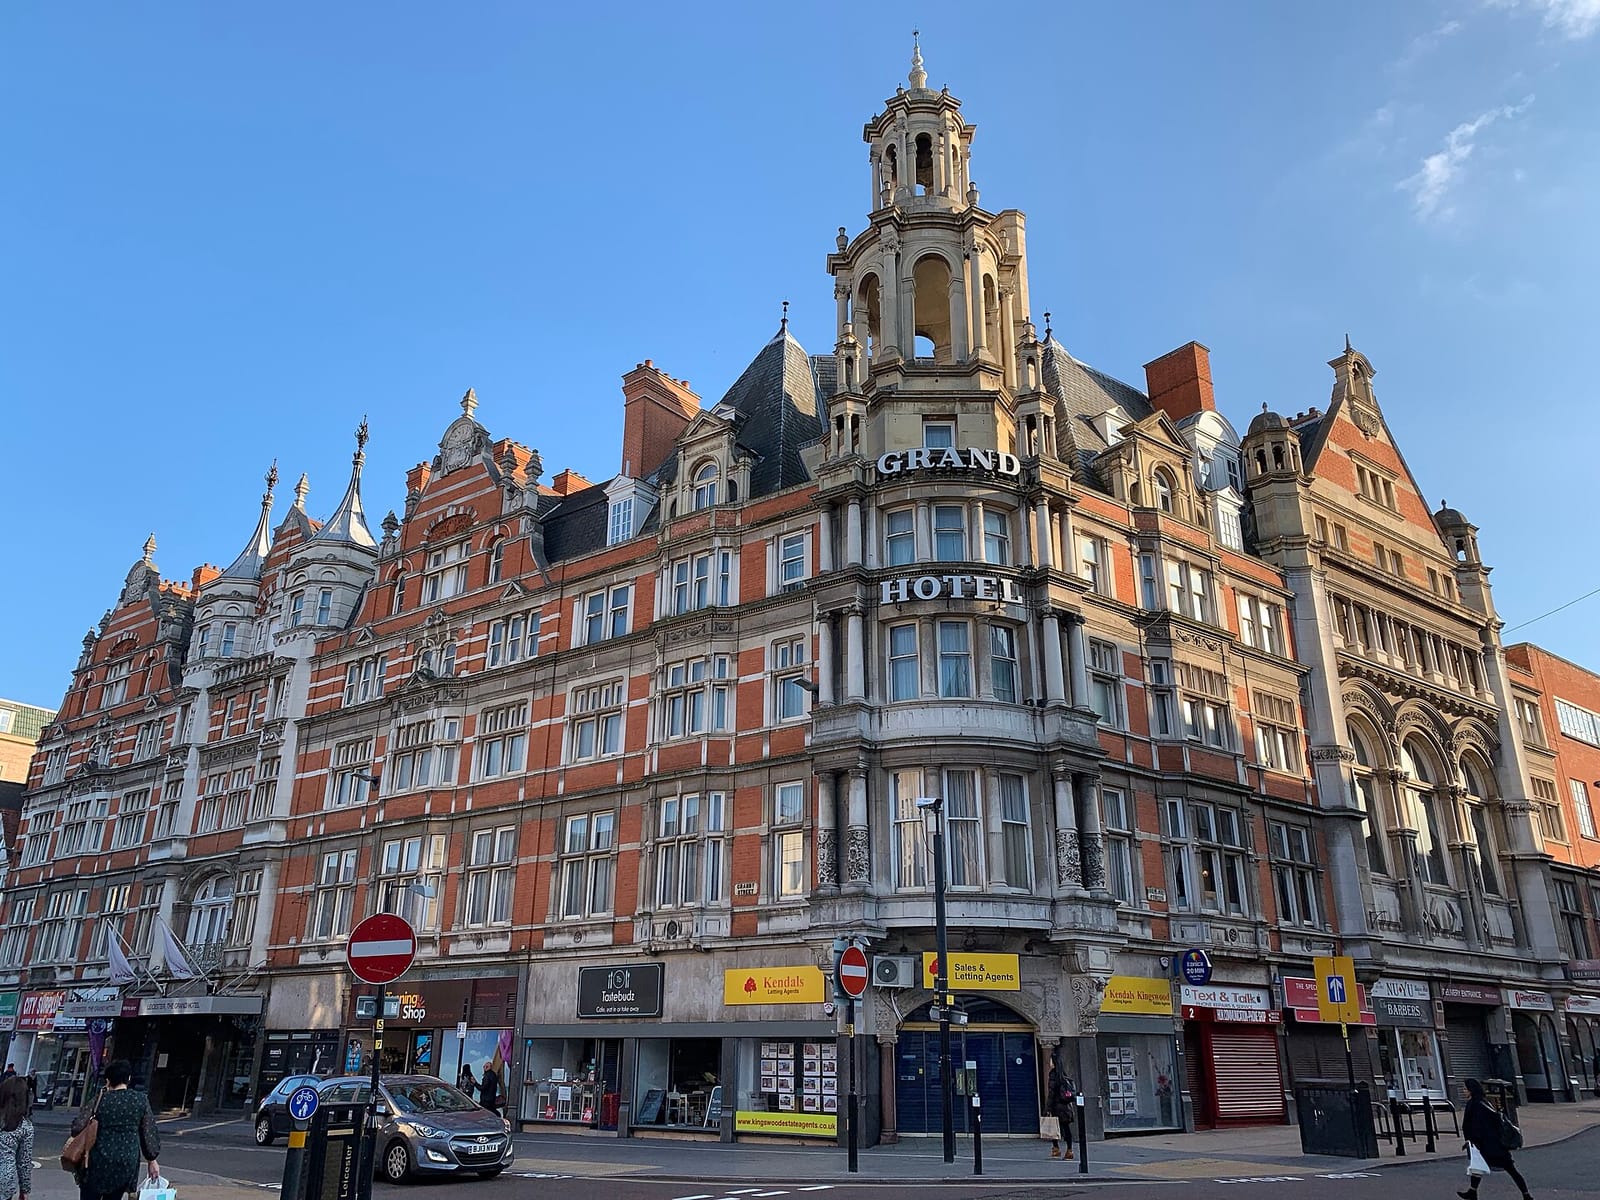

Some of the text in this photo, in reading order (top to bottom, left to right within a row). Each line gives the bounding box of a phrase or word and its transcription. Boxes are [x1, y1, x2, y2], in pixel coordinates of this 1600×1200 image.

[877, 446, 1021, 476] GRAND
[880, 575, 1023, 605] HOTEL
[954, 963, 985, 972] Sales &
[763, 976, 805, 988] Kendals
[954, 972, 1014, 983] Letting Agents
[601, 990, 635, 1002] Tastebudz
[1109, 990, 1170, 1002] Kendals Kingswood
[1191, 989, 1216, 1002] Text
[1219, 991, 1230, 1003] &
[1231, 992, 1257, 1004] Talk
[402, 1005, 426, 1023] Shop
[1189, 1008, 1195, 1018] 2
[1387, 1003, 1421, 1017] BARBERS
[737, 1118, 836, 1130] www.kingswoodestateagents.co.uk
[340, 1145, 353, 1198] Leicester
